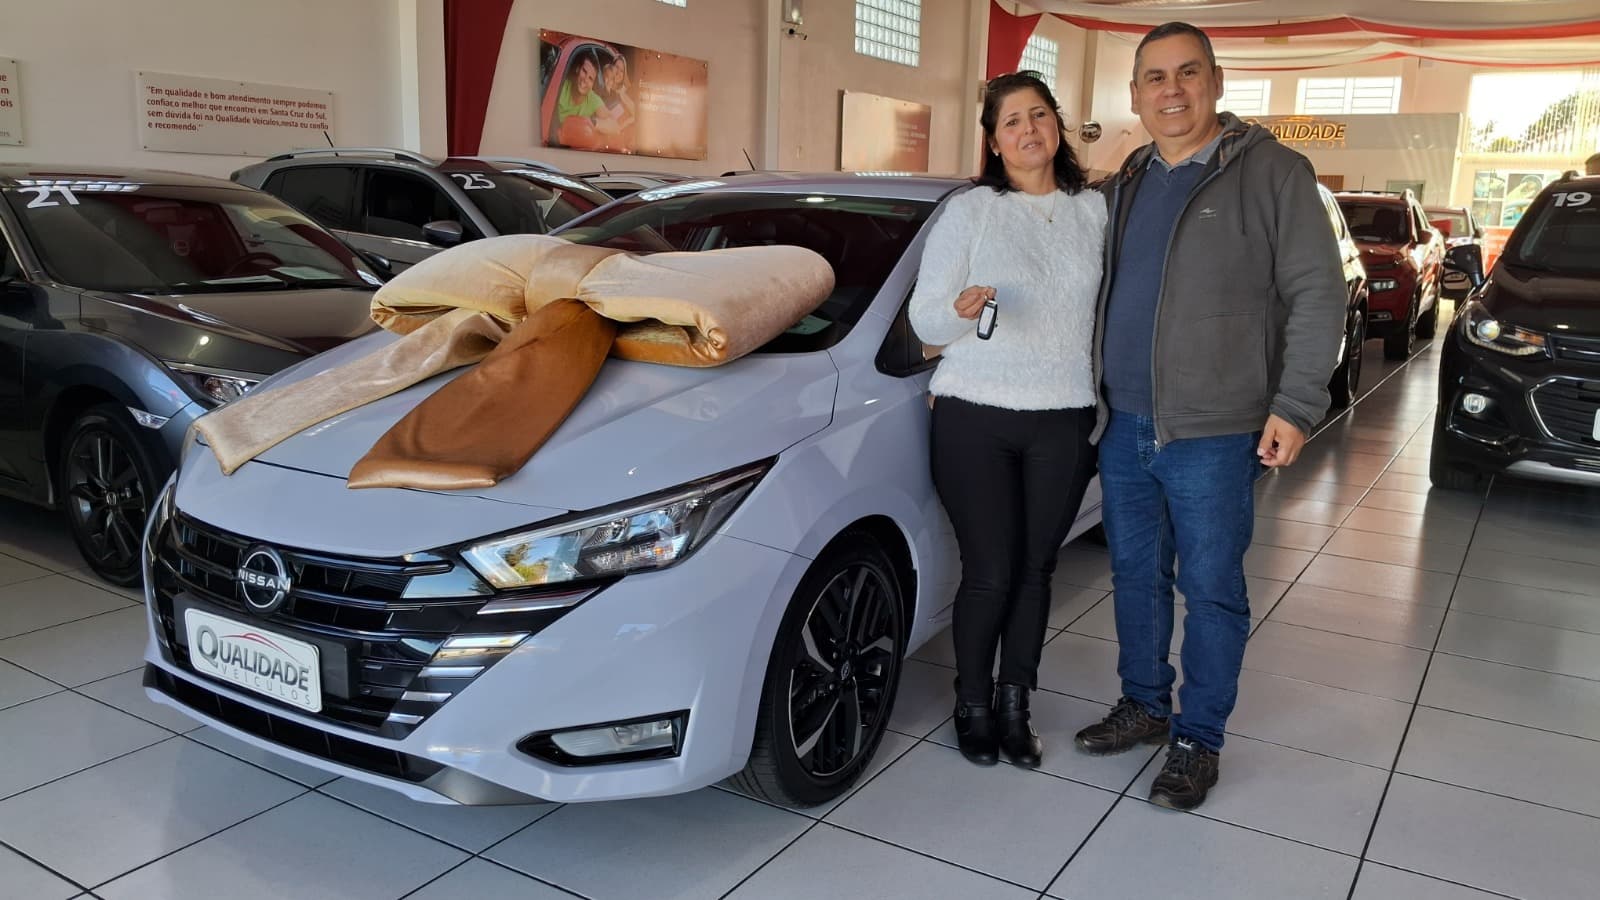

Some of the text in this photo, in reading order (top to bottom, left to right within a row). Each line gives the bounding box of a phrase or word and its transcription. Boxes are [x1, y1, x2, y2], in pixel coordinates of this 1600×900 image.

[165, 88, 202, 98] qualidade
[210, 91, 226, 100] bom
[228, 94, 271, 105] atendimento
[272, 99, 297, 108] sempre
[297, 101, 327, 110] podemos
[181, 101, 207, 110] melhor
[208, 104, 223, 112] que
[224, 105, 257, 114] encontrei
[270, 107, 289, 116] Santa
[290, 110, 304, 118] Cruz
[305, 111, 314, 119] do
[147, 110, 163, 118] sem
[193, 111, 203, 120] foi
[215, 114, 251, 124] Qualidade
[309, 122, 329, 130] confio
[1246, 118, 1347, 142] ALIDADE
[451, 173, 497, 190] 25
[17, 185, 80, 209] 21
[1552, 191, 1593, 208] 19
[238, 568, 292, 594] NISSAN
[196, 625, 310, 691] QUALIDADE
